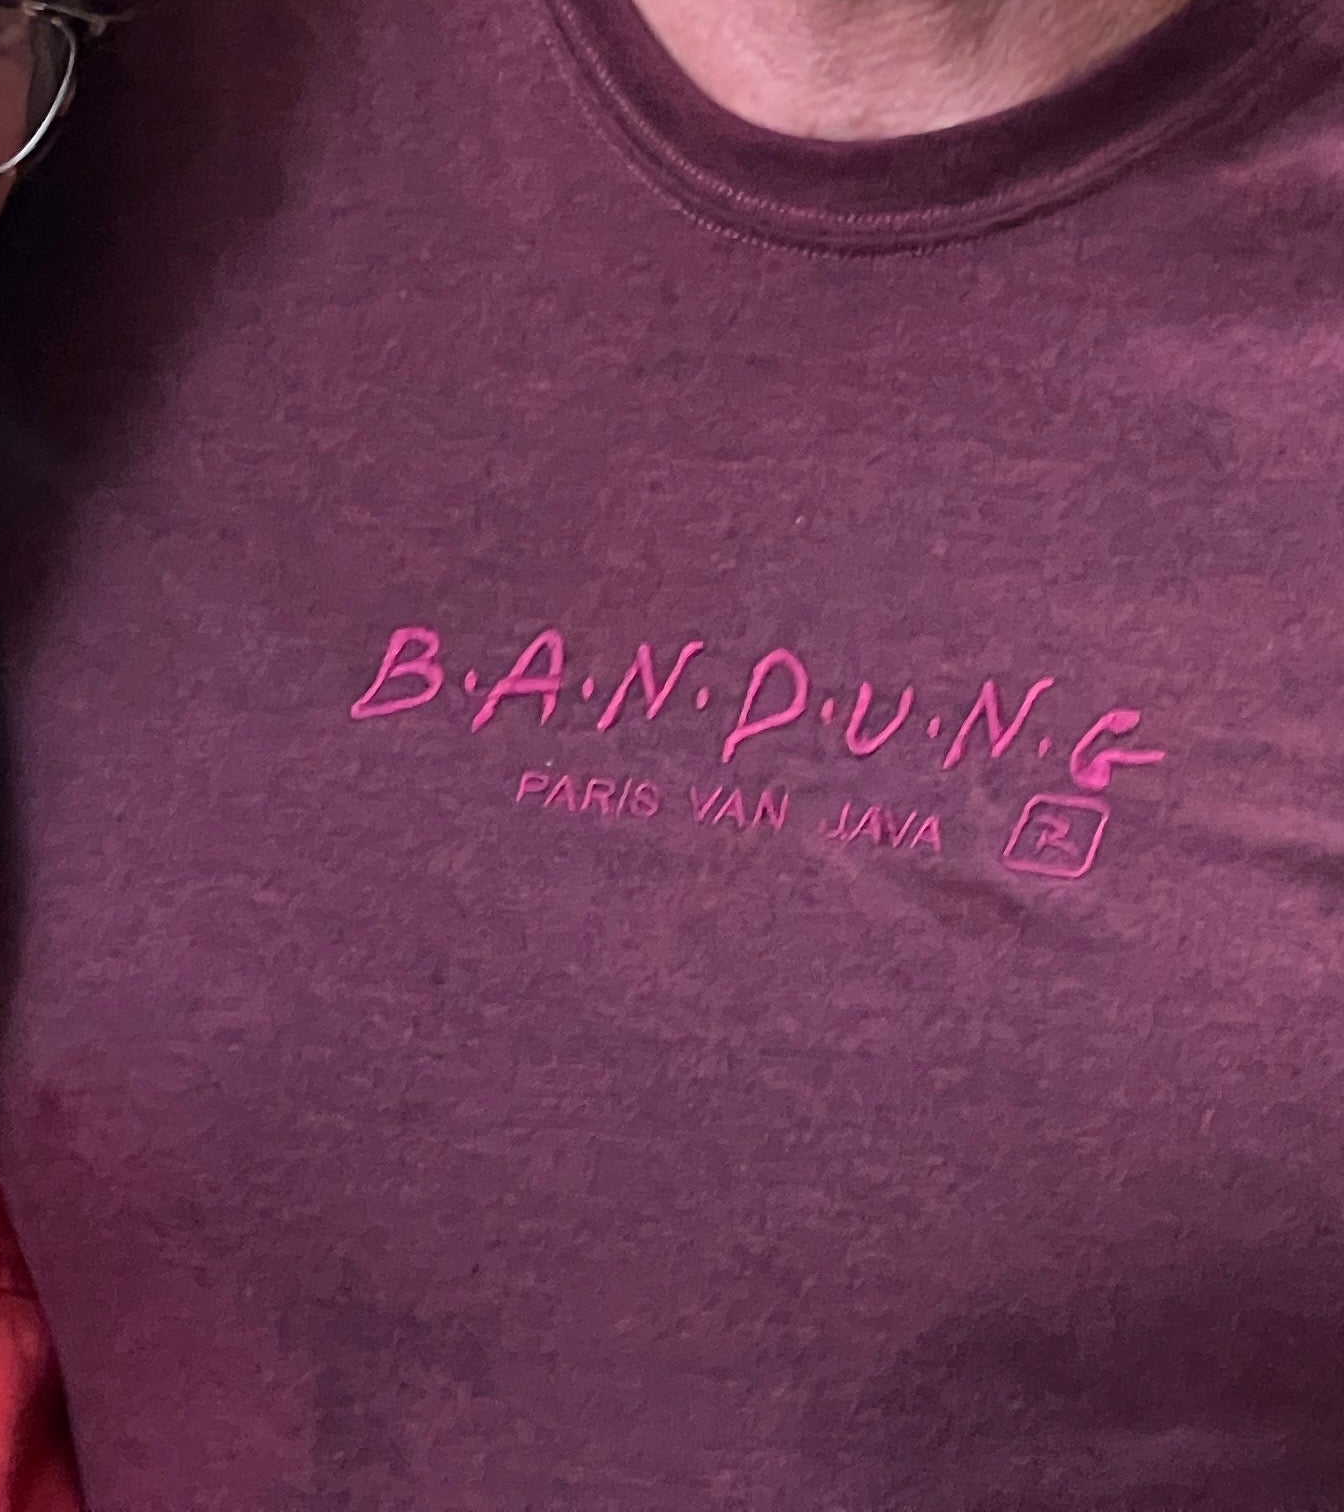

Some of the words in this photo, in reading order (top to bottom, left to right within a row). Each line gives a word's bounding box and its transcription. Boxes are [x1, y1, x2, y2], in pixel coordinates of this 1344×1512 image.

[516, 771, 660, 817] PARIS
[690, 785, 790, 831] VAN
[819, 801, 942, 852] JAVA
